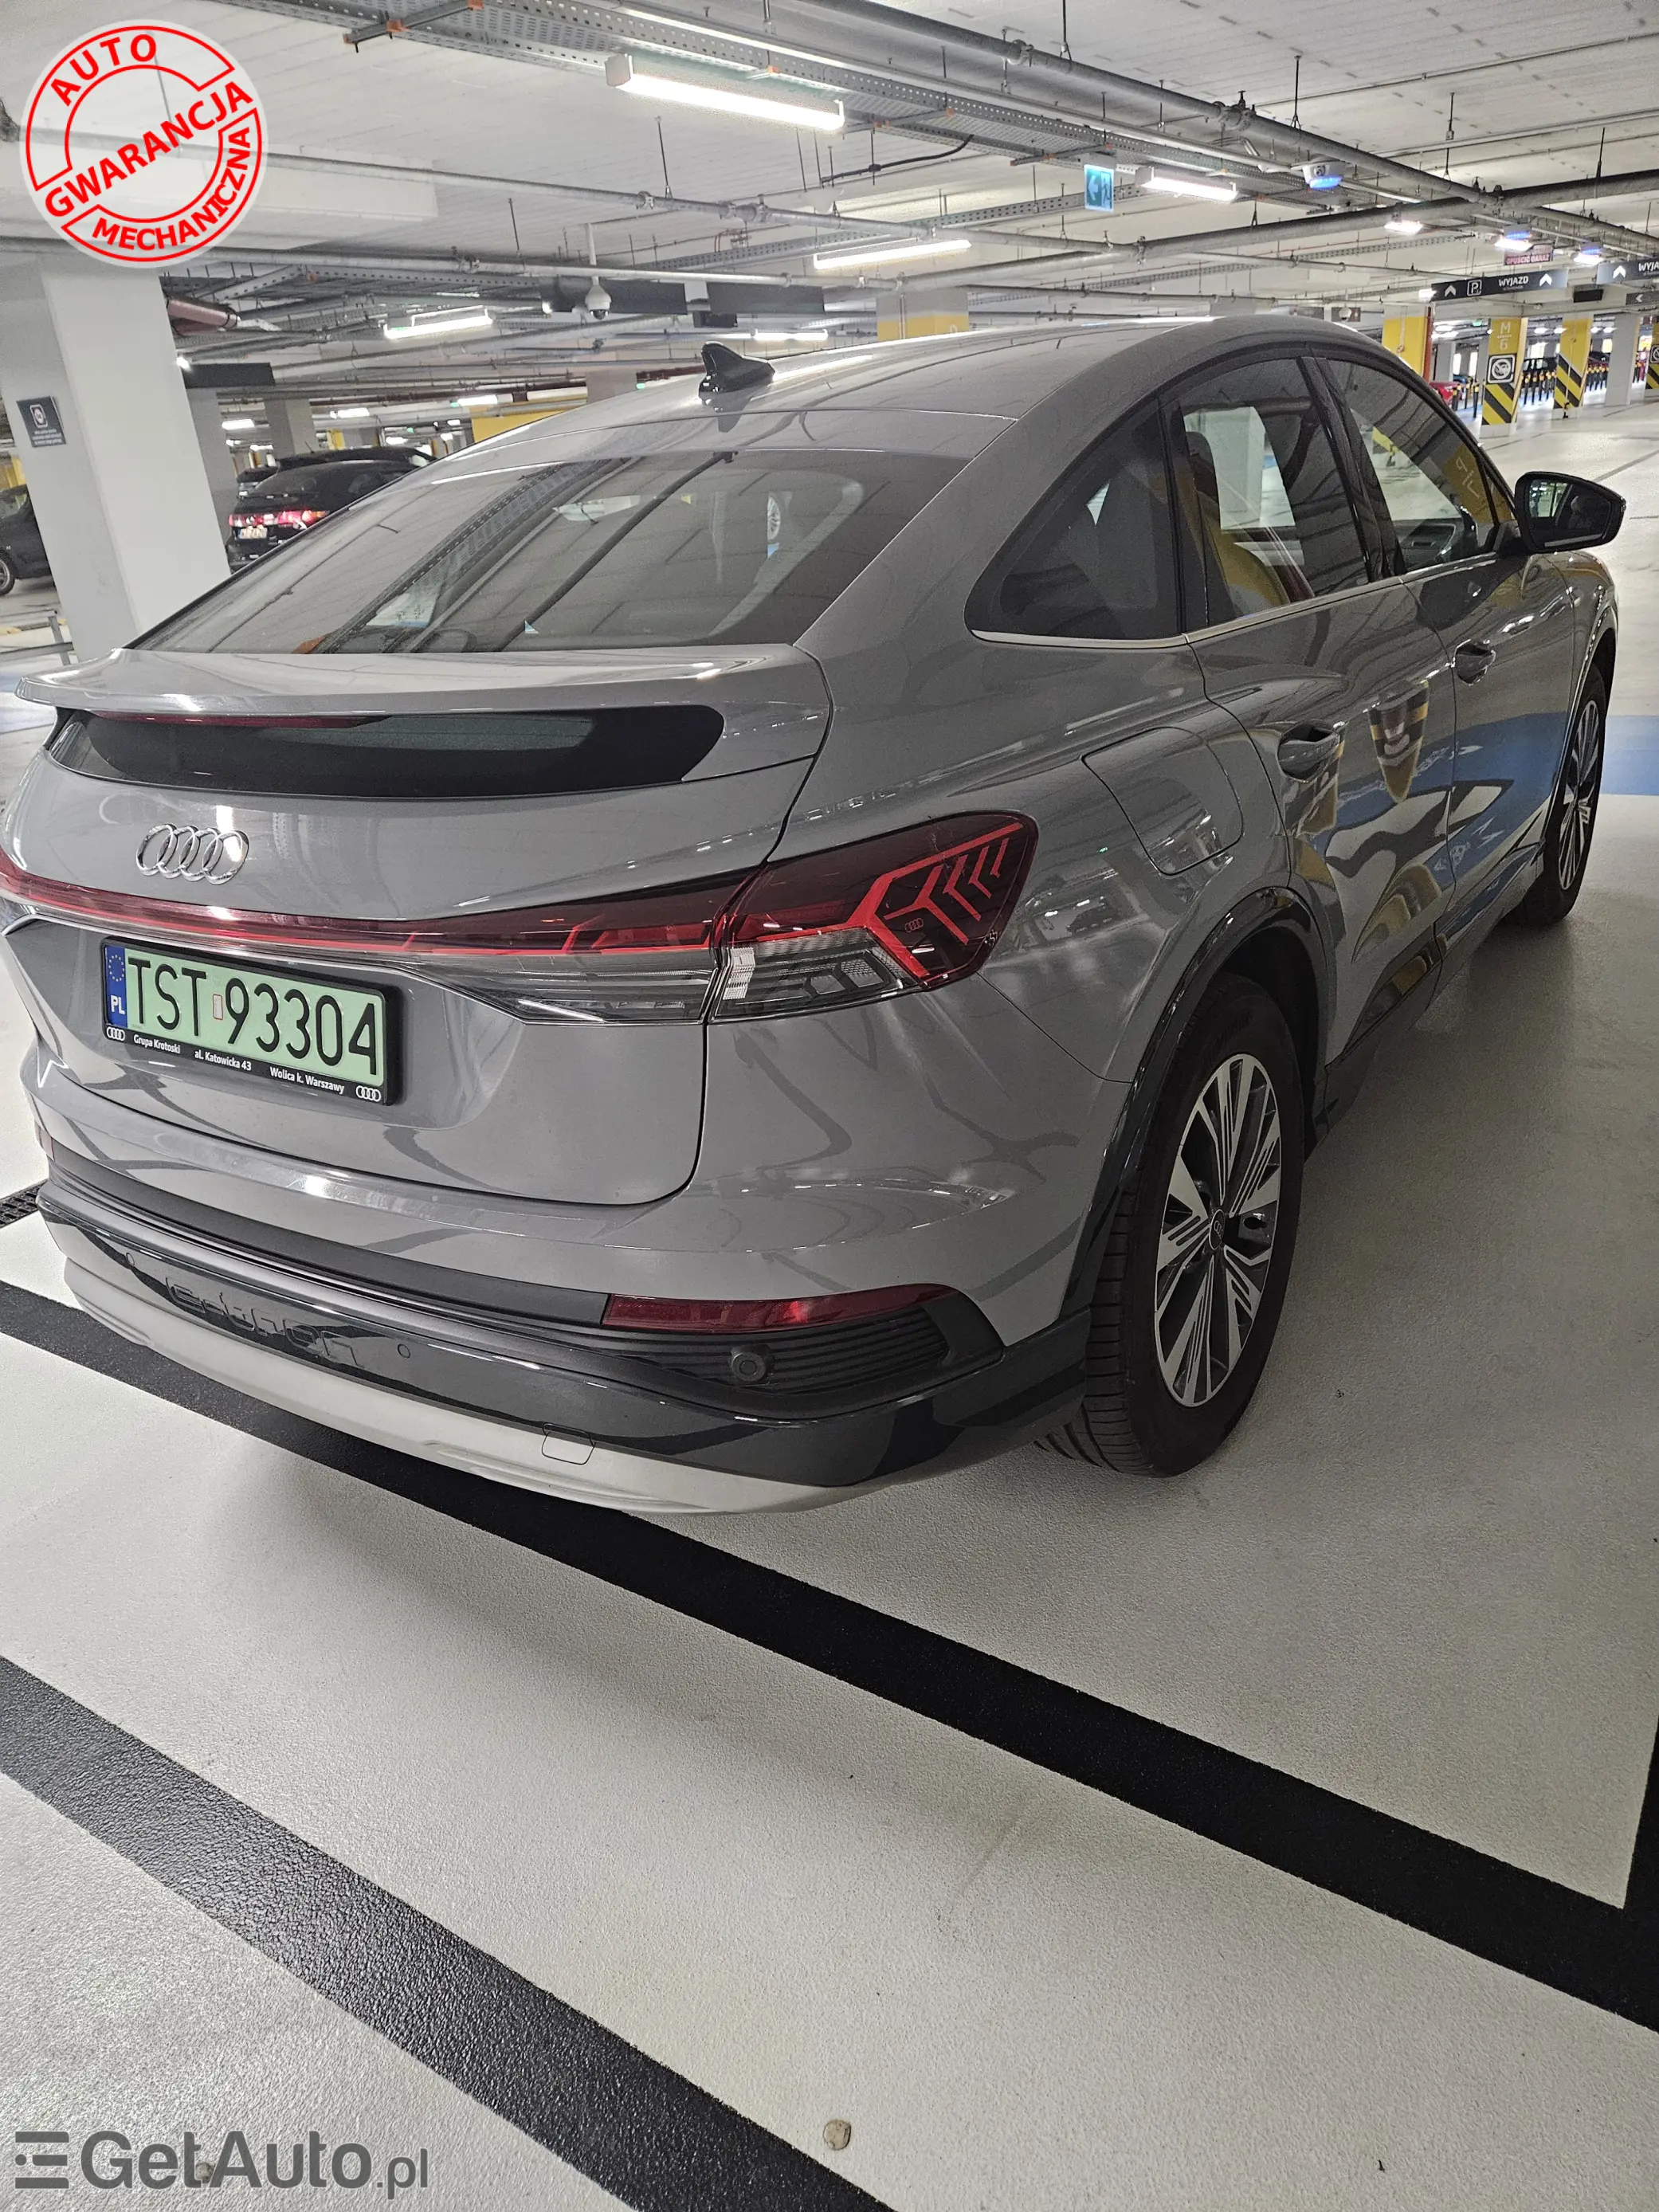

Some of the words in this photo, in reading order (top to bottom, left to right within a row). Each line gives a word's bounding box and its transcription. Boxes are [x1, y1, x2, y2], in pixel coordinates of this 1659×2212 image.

[1499, 276, 1529, 287] WYJAZD
[1500, 321, 1511, 334] M
[110, 994, 126, 1015] PL
[127, 956, 207, 1037] TST
[225, 977, 378, 1076] 93304
[133, 1033, 153, 1049] Grupa
[154, 1040, 181, 1054] Krotoski
[194, 1049, 204, 1060] al.
[205, 1051, 241, 1069] Katowicka
[241, 1060, 252, 1071] 43
[269, 1066, 295, 1081] Wolica
[296, 1072, 304, 1084] k.
[305, 1074, 345, 1094] Warszawy
